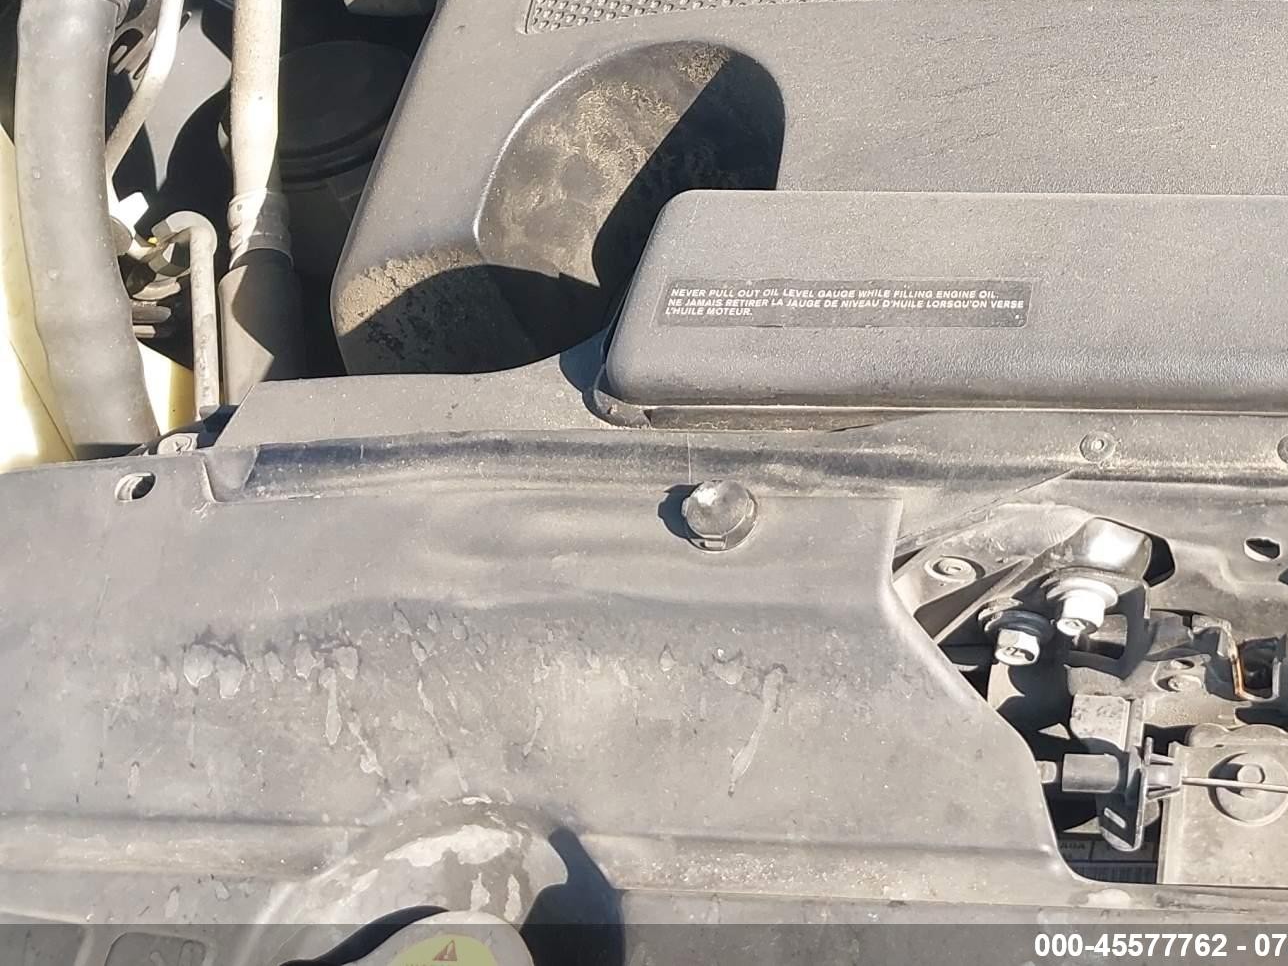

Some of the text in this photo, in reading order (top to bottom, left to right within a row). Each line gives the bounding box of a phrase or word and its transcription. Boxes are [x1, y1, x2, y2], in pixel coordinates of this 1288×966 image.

[670, 288, 1000, 299] NEVER PULL OUT OIL LEVEL GAUGE WHILE FILLING ENGINE OIL.
[667, 298, 1025, 309] NE JAMAIS RETIRER LA JAUGE DE NIVEAU D'HUILE LORSQU'ON VERSE
[664, 306, 753, 316] L'HUILE MOTEUR.
